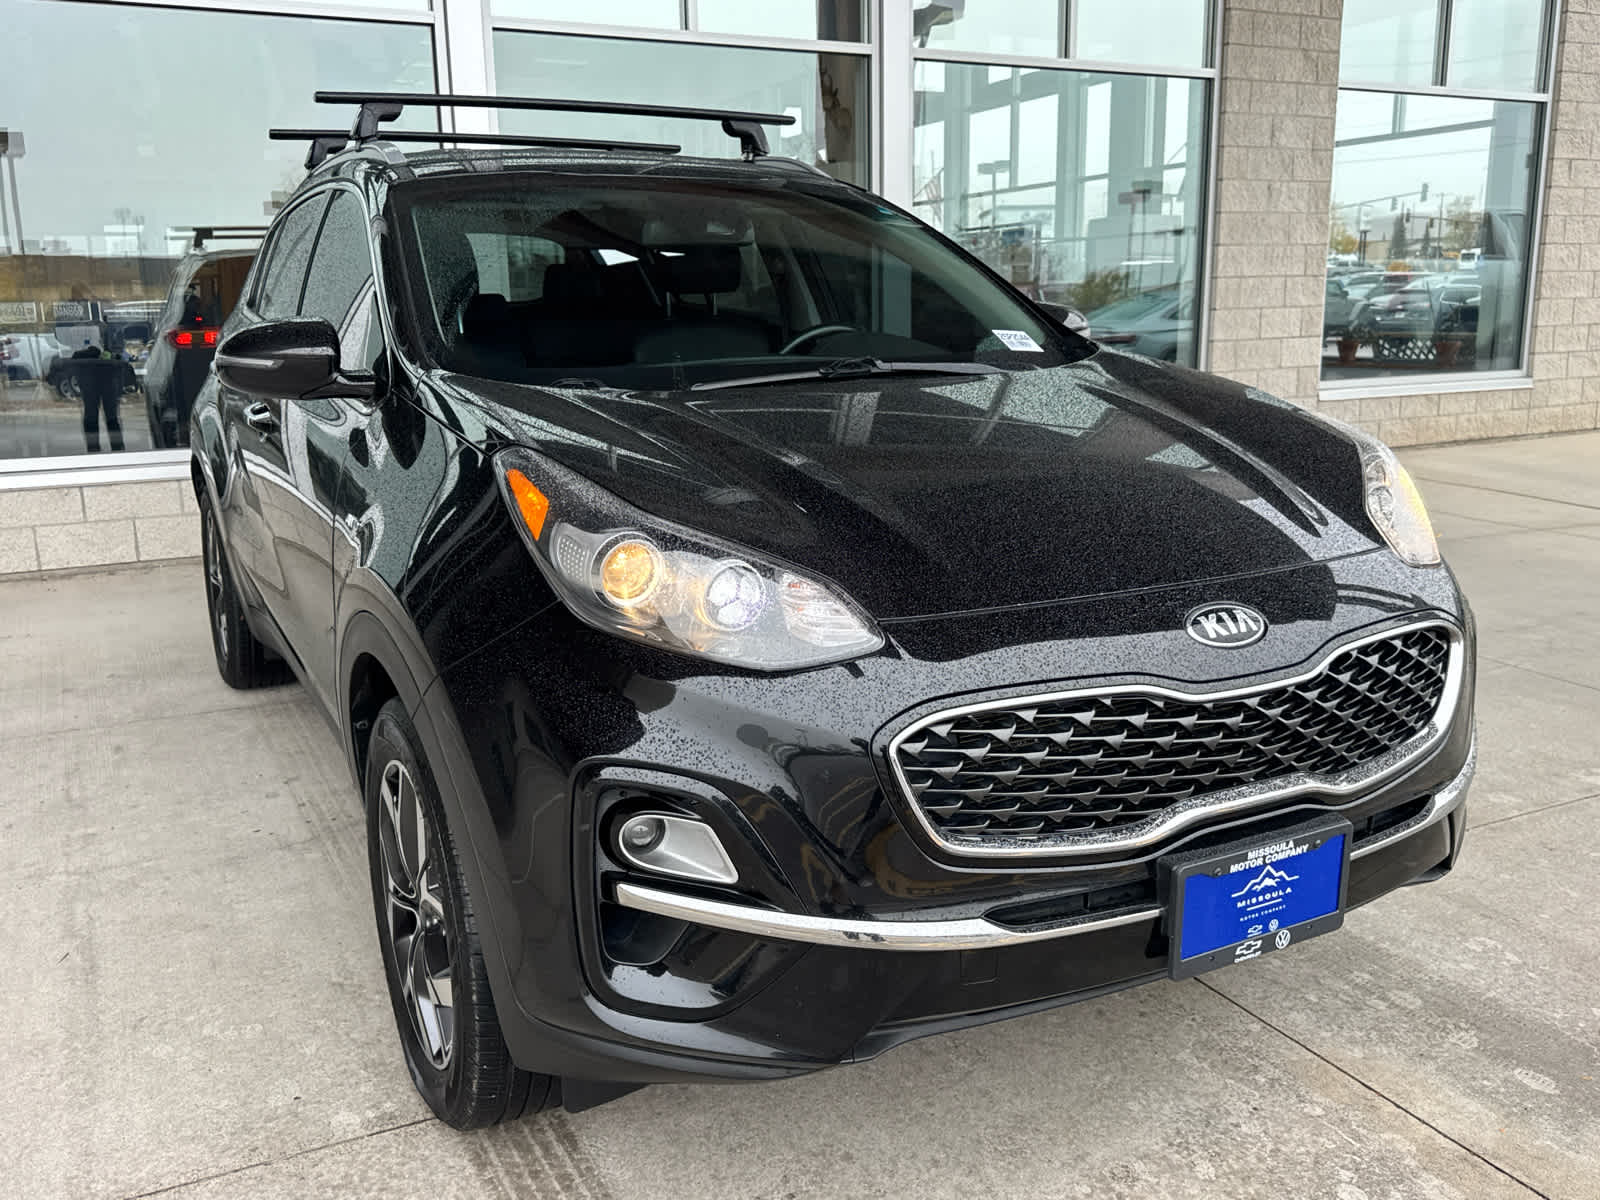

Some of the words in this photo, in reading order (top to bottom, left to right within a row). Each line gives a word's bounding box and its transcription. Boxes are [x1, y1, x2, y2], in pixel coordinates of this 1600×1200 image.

[1197, 609, 1259, 639] KIA
[1230, 857, 1264, 873] MOTOR
[1265, 843, 1309, 864] COMPANY
[1247, 840, 1295, 860] MISSOULA
[1237, 887, 1292, 908] MISSOULA
